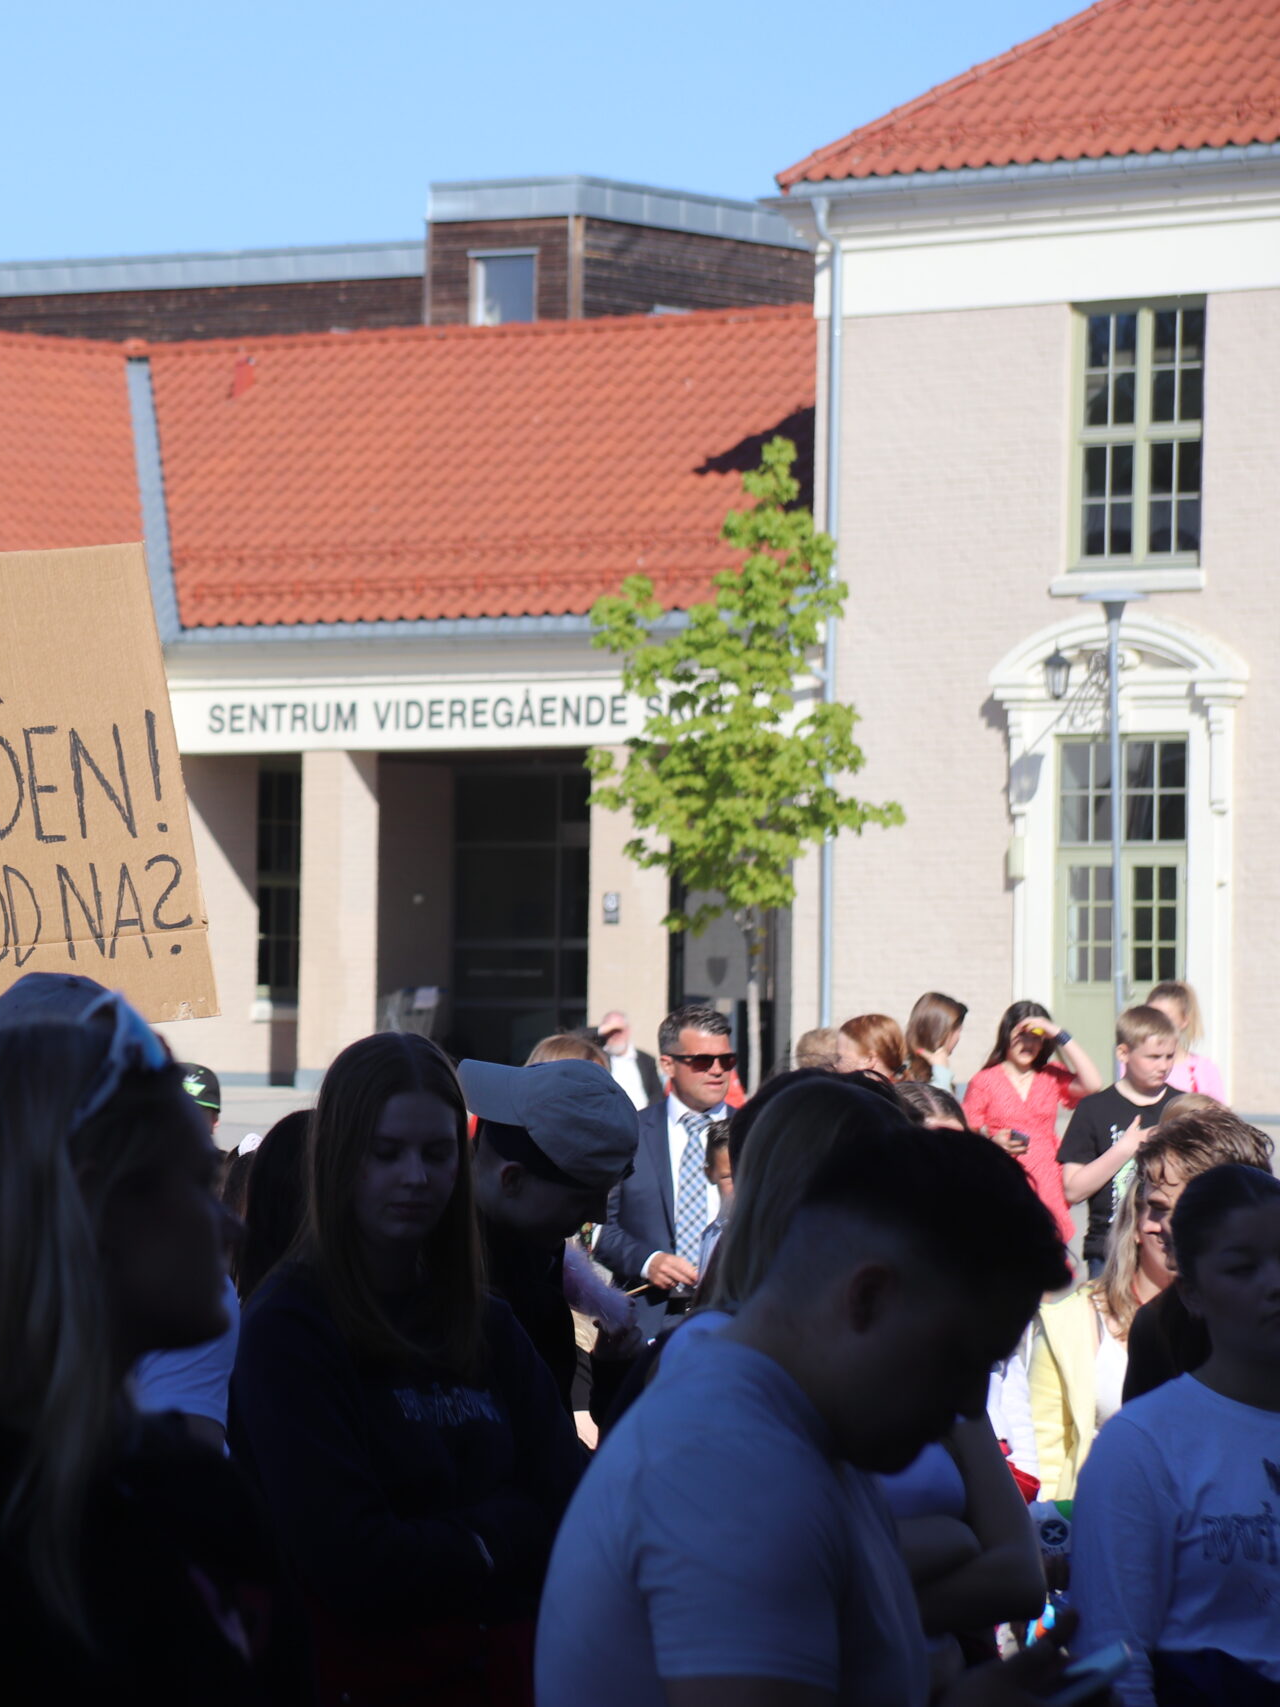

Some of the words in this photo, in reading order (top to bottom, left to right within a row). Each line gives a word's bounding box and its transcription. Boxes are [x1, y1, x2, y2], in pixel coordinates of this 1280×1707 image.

[209, 702, 358, 733] SENTRUM
[374, 688, 627, 730] VIDEREGÅENDE
[56, 854, 195, 961] NA?
